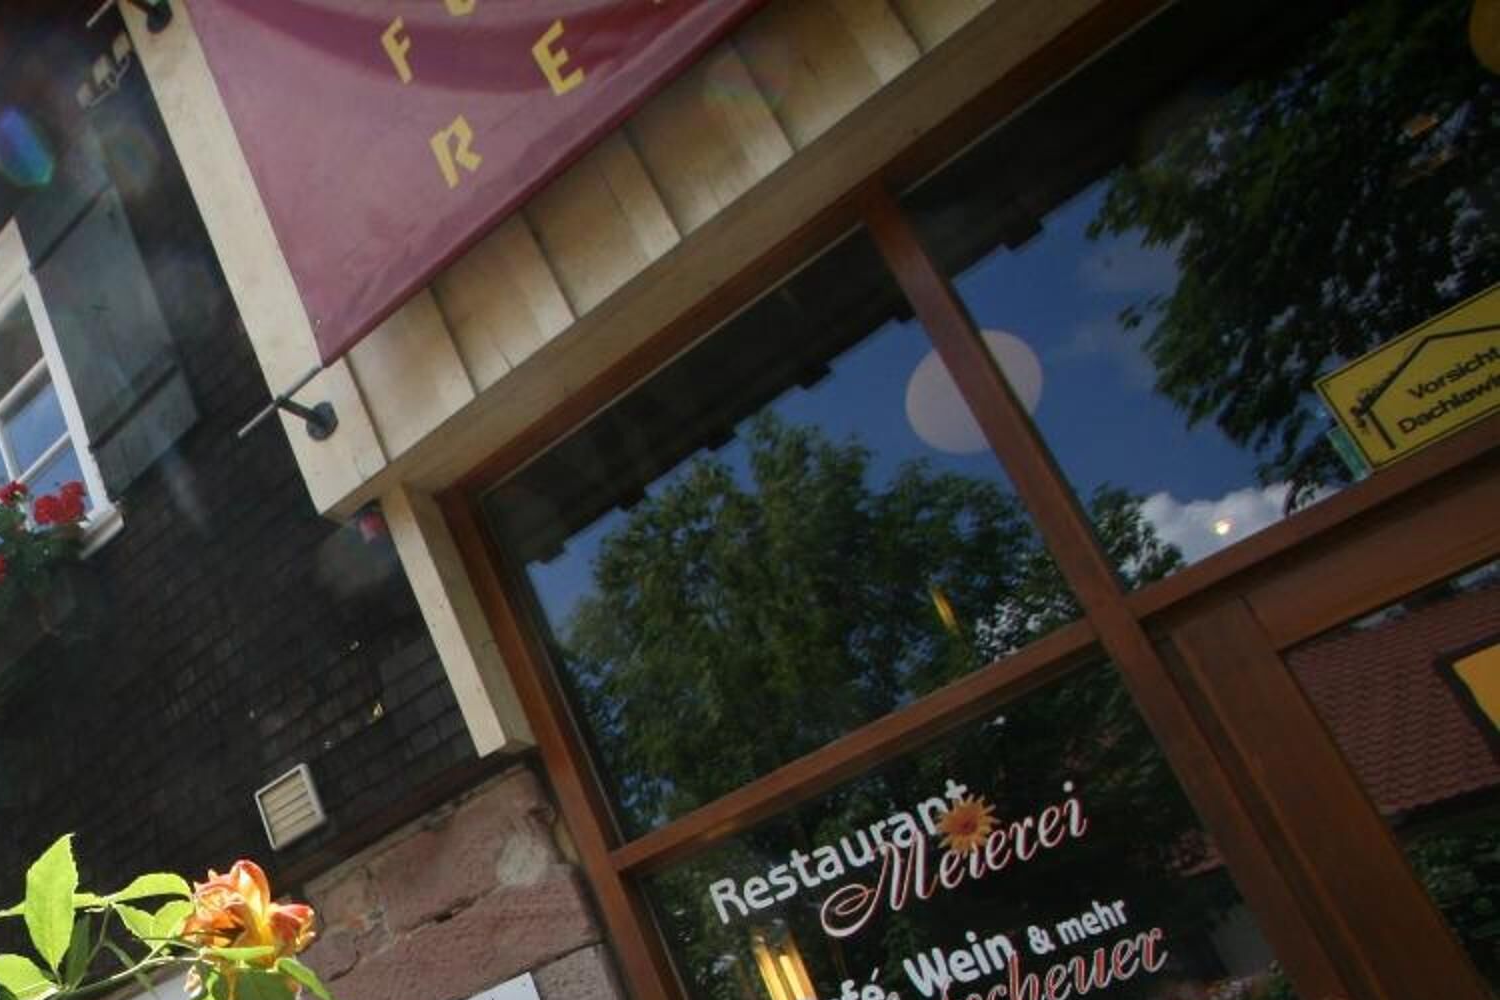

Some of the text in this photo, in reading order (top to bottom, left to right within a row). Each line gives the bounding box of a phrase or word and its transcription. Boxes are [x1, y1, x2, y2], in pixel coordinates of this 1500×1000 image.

[820, 781, 1088, 937] Meierei
[903, 930, 1014, 998] Wein
[1027, 925, 1056, 956] &
[1056, 899, 1128, 945] mehr
